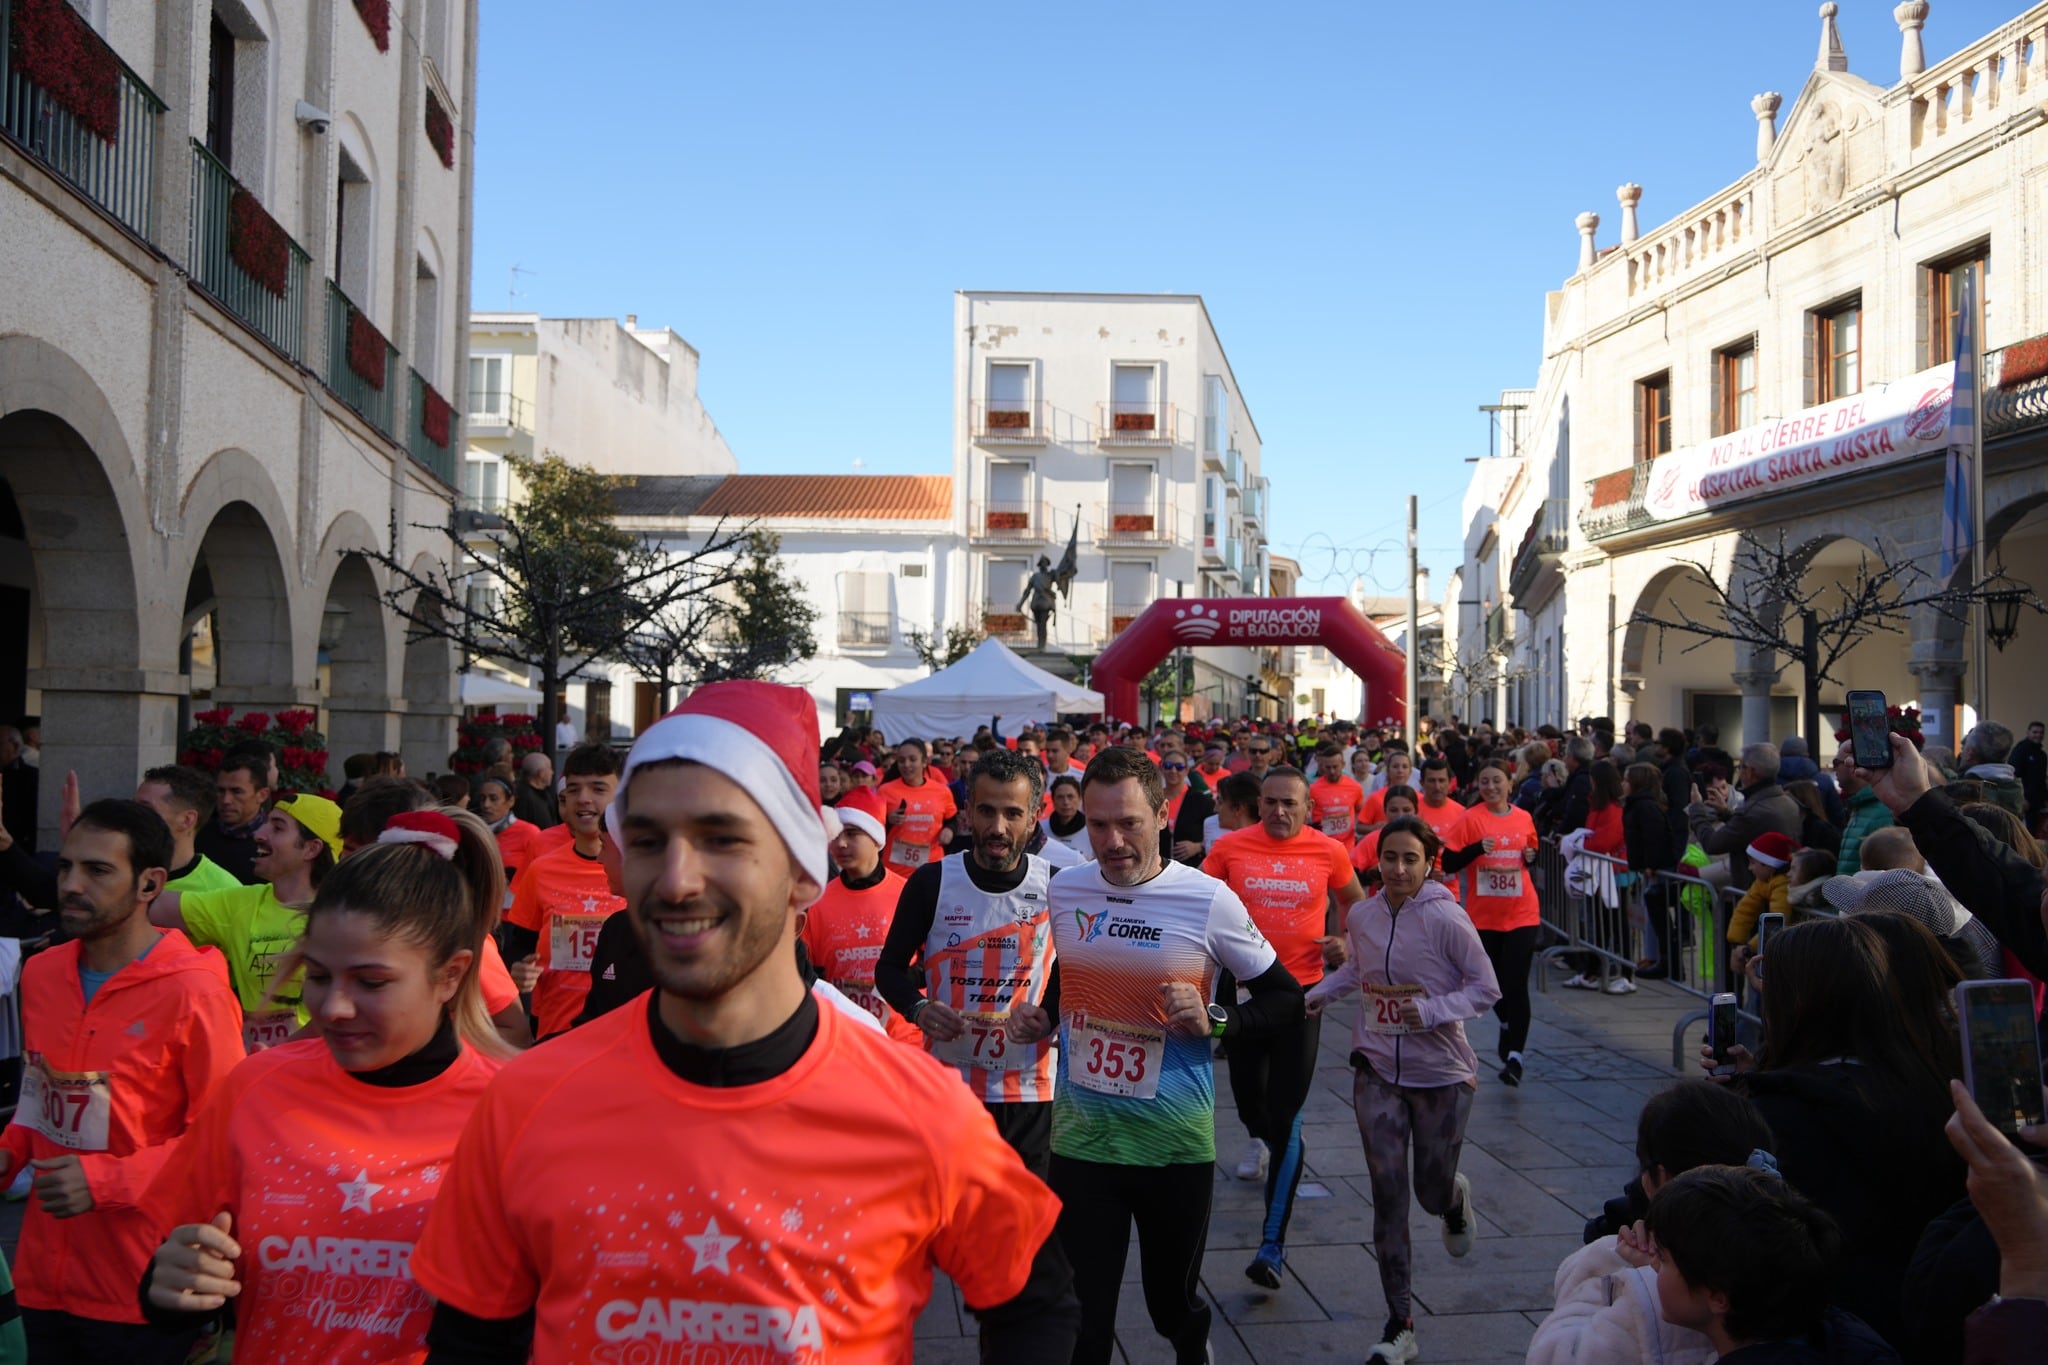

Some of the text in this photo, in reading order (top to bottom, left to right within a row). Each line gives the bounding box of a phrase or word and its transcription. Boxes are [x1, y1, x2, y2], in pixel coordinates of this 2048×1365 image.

[1709, 402, 1867, 467] NO AL CIERRE DEL
[1688, 467, 1763, 502] HOSPITAL
[1768, 451, 1825, 483] SANTA
[1830, 426, 1896, 466] JUSTA
[1229, 606, 1321, 624] DIPUTACIÓN
[1229, 624, 1320, 637] DE BADAJOZ
[1330, 819, 1348, 831] 305
[905, 848, 921, 862] 56
[1244, 876, 1311, 893] CARRERA
[1489, 874, 1517, 890] 384
[1111, 917, 1146, 925] VILLANUEVA
[1108, 923, 1163, 941] CORRE
[568, 930, 601, 959] 15
[949, 976, 1032, 987] TOSTADITA
[968, 993, 1012, 1004] TEAM
[971, 1027, 1006, 1059] 73
[1086, 1037, 1147, 1083] 353
[42, 1081, 91, 1133] 307
[258, 1235, 417, 1280] CARRER
[307, 1296, 412, 1340] Navidad
[595, 1297, 823, 1354] CARRERA
